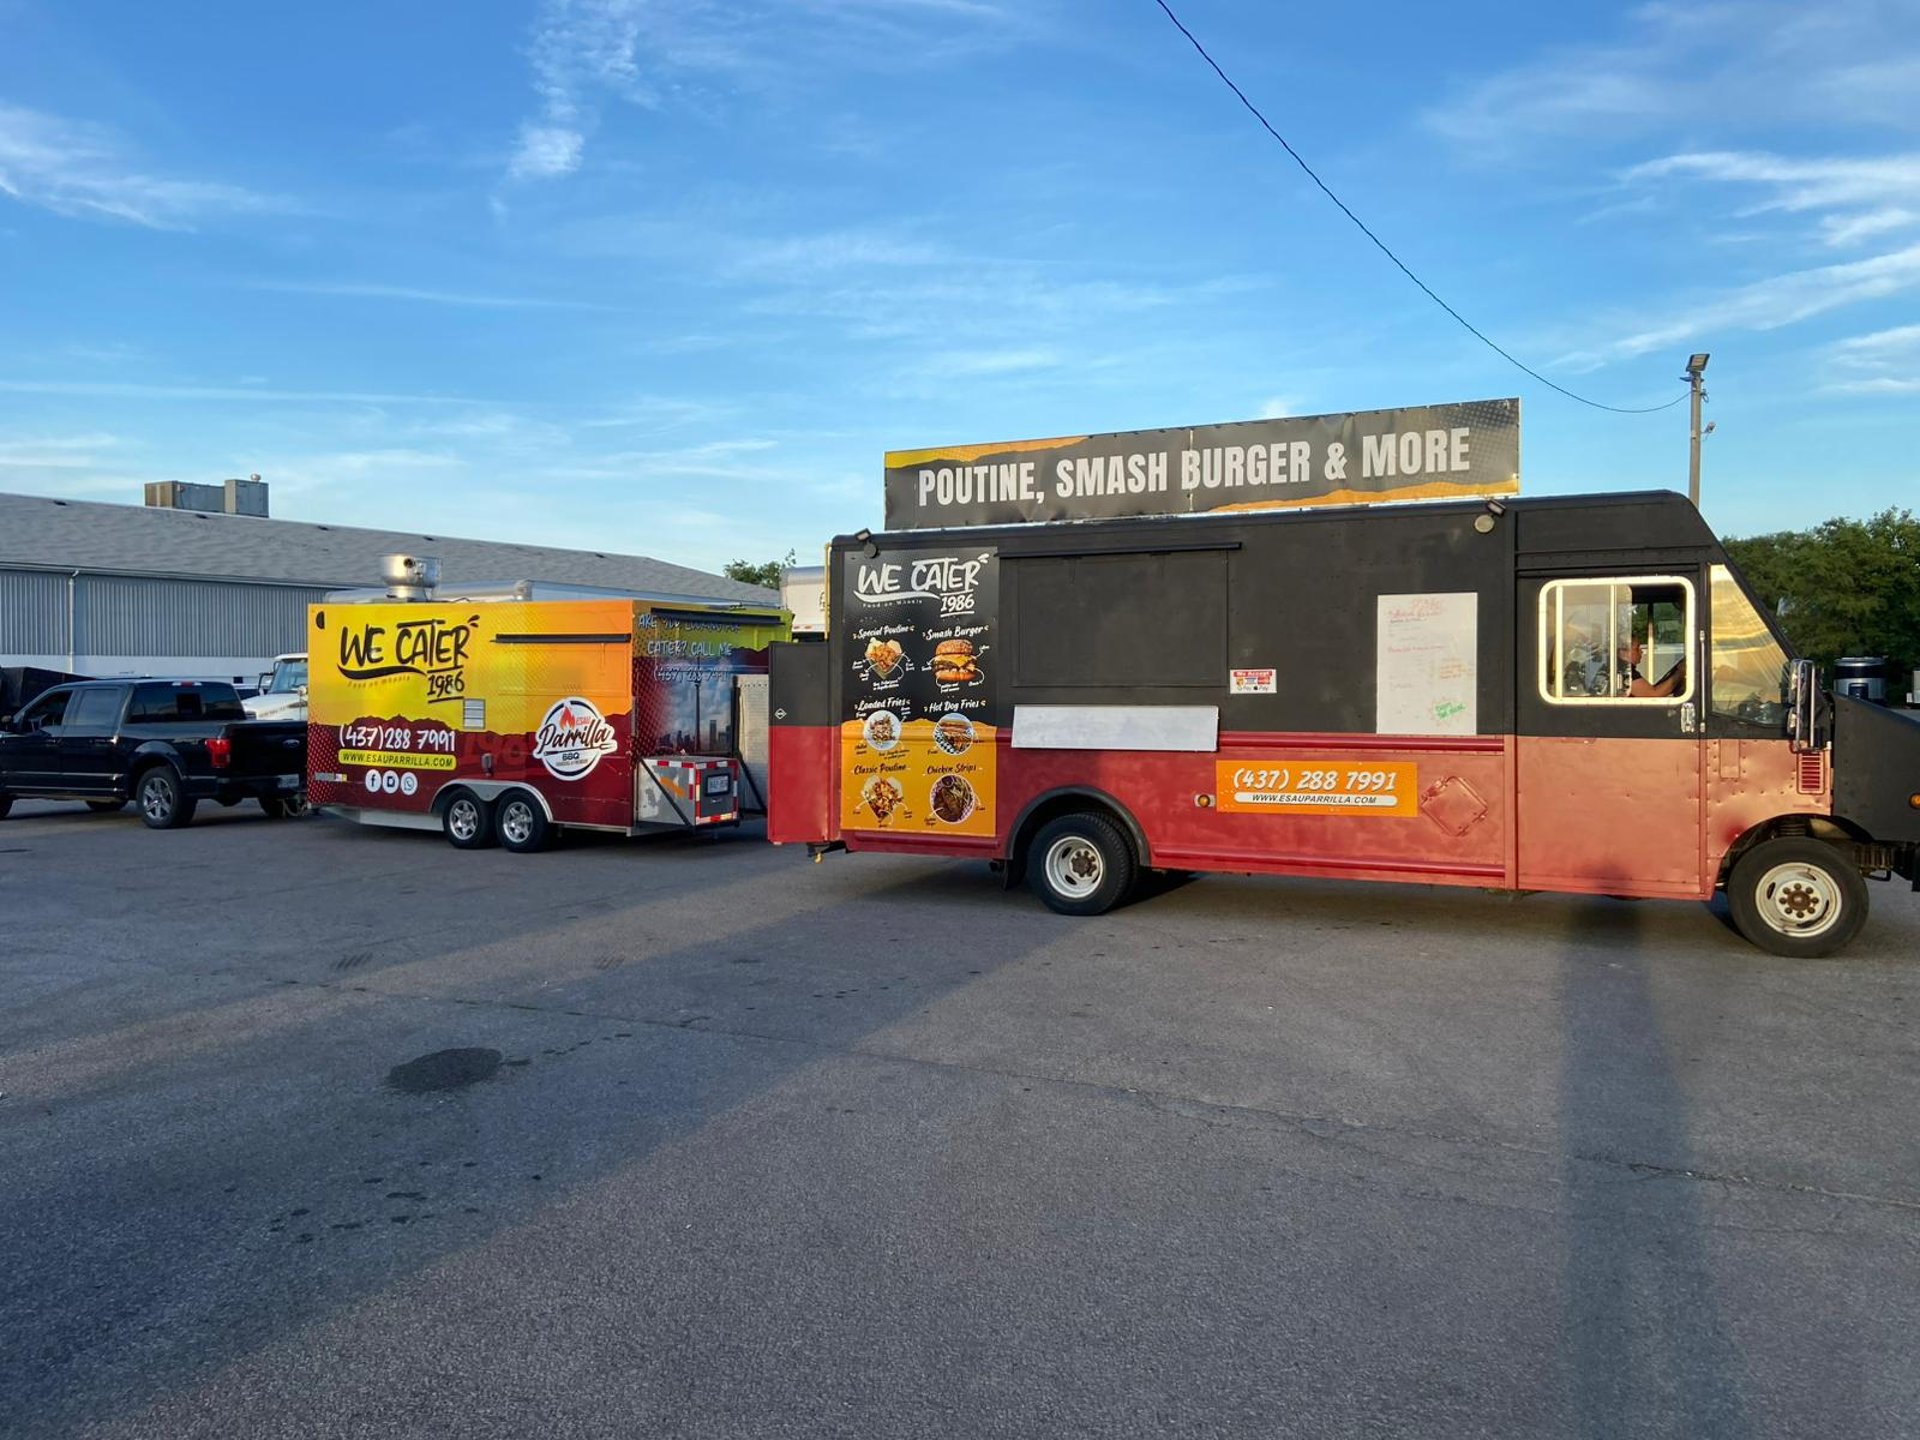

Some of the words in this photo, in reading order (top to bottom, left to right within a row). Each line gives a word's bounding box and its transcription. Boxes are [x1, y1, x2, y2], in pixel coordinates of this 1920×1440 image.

[918, 462, 1045, 507] POUTINE,
[1056, 452, 1168, 498] SMASH
[1181, 441, 1310, 490] BURGER
[1324, 442, 1347, 480] &
[1363, 427, 1470, 478] MORE
[858, 563, 902, 594] WE
[911, 558, 981, 592] CATER
[940, 593, 975, 612] 1986
[857, 627, 883, 640] Special
[884, 624, 909, 636] Poutine
[926, 628, 952, 641] Smash
[954, 625, 984, 637] Burger
[340, 623, 386, 667] WE
[396, 618, 470, 667] CATER
[647, 640, 687, 655] CATER?
[691, 641, 715, 656] CALL
[427, 670, 465, 698] 1986
[857, 700, 886, 711] Loaded
[887, 697, 906, 708] Fries
[929, 700, 943, 713] Hot
[944, 700, 959, 712] Dog
[960, 698, 980, 710] Fries
[416, 729, 456, 752] 7991
[537, 719, 613, 754] Parrilla
[342, 752, 453, 768] WWW.ESAUPARRILLA.COM
[854, 764, 878, 775] Classic
[880, 763, 906, 774] Poutine
[927, 765, 953, 775] Chicken
[955, 763, 977, 774] Strips
[1233, 767, 1290, 790] (437)
[1296, 770, 1338, 790] 288
[1346, 771, 1397, 792] 7991
